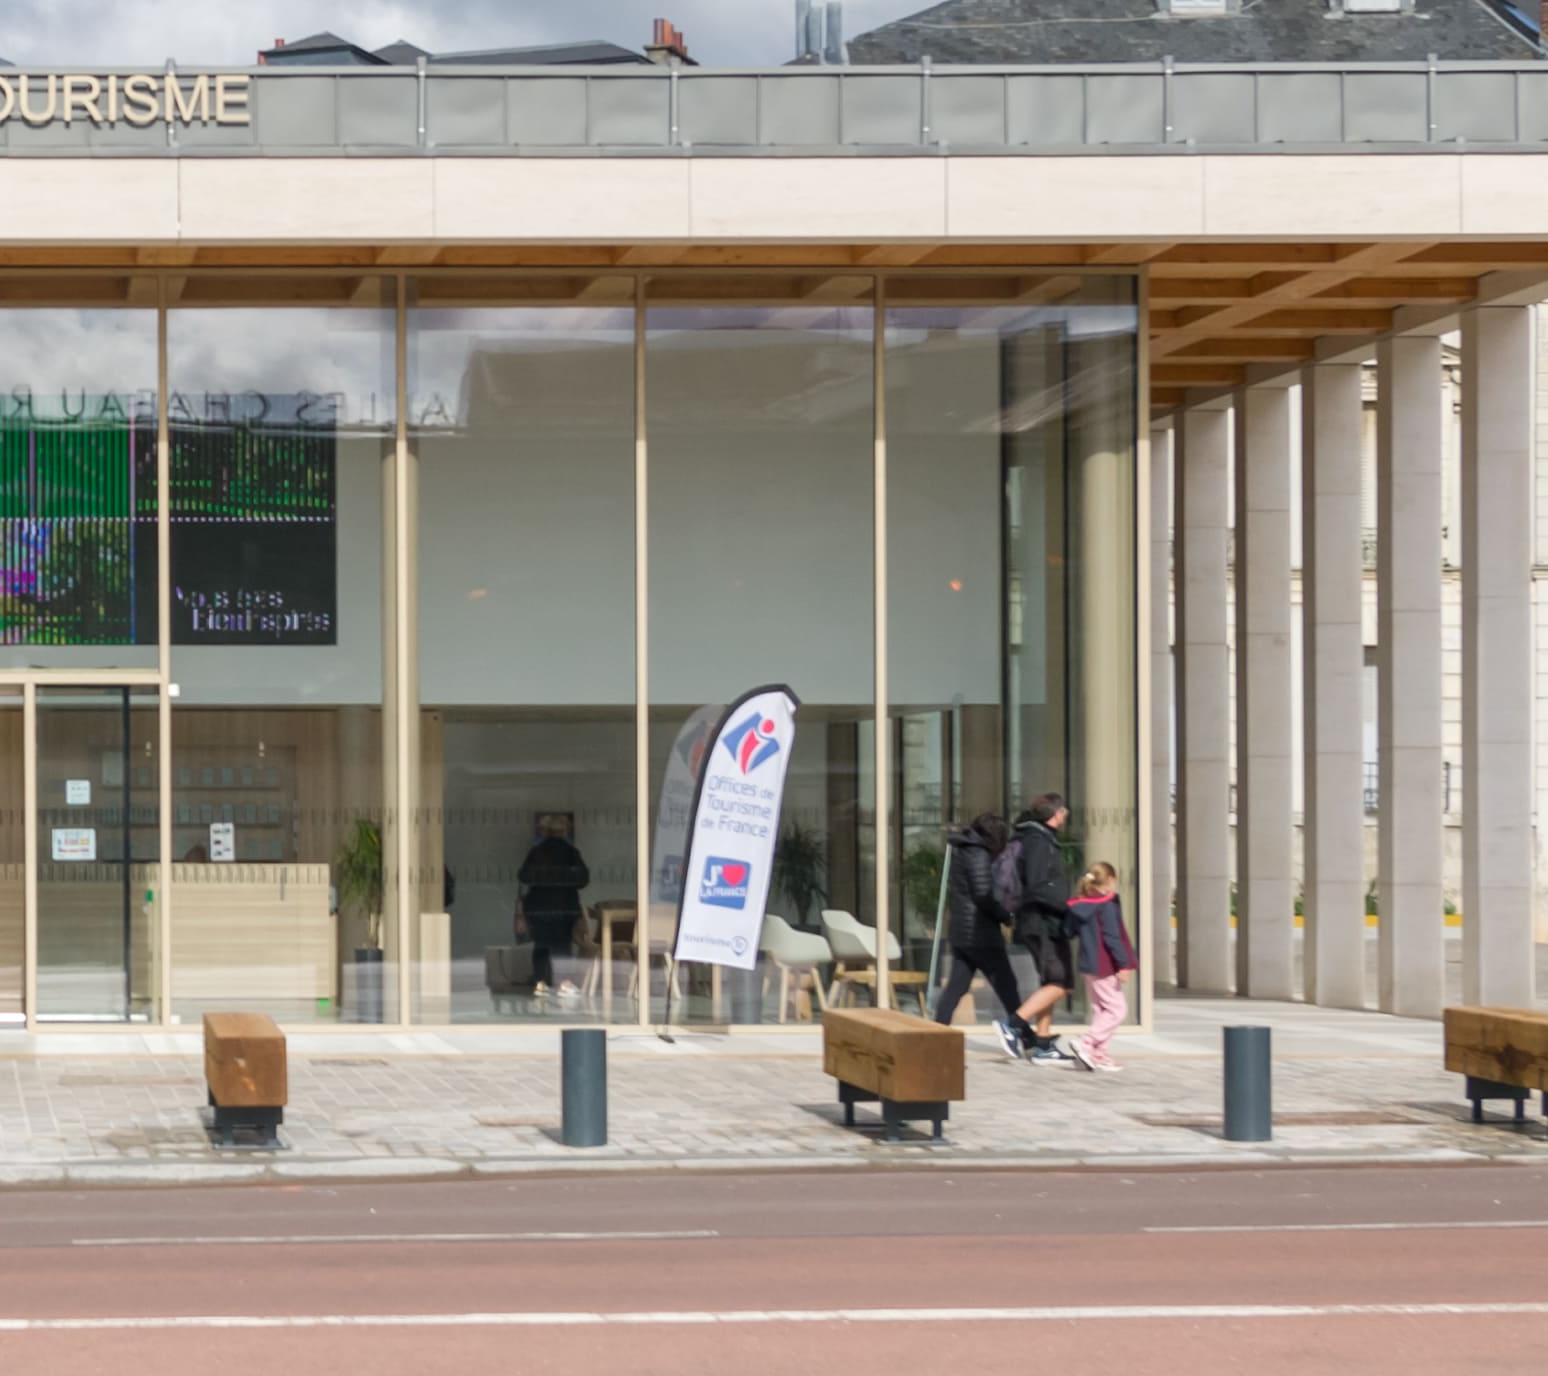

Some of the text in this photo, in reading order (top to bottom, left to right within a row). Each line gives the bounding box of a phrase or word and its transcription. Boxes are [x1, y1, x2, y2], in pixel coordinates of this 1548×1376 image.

[708, 775, 758, 797] Offices
[707, 793, 772, 819] Tourisme
[718, 815, 769, 838] France
